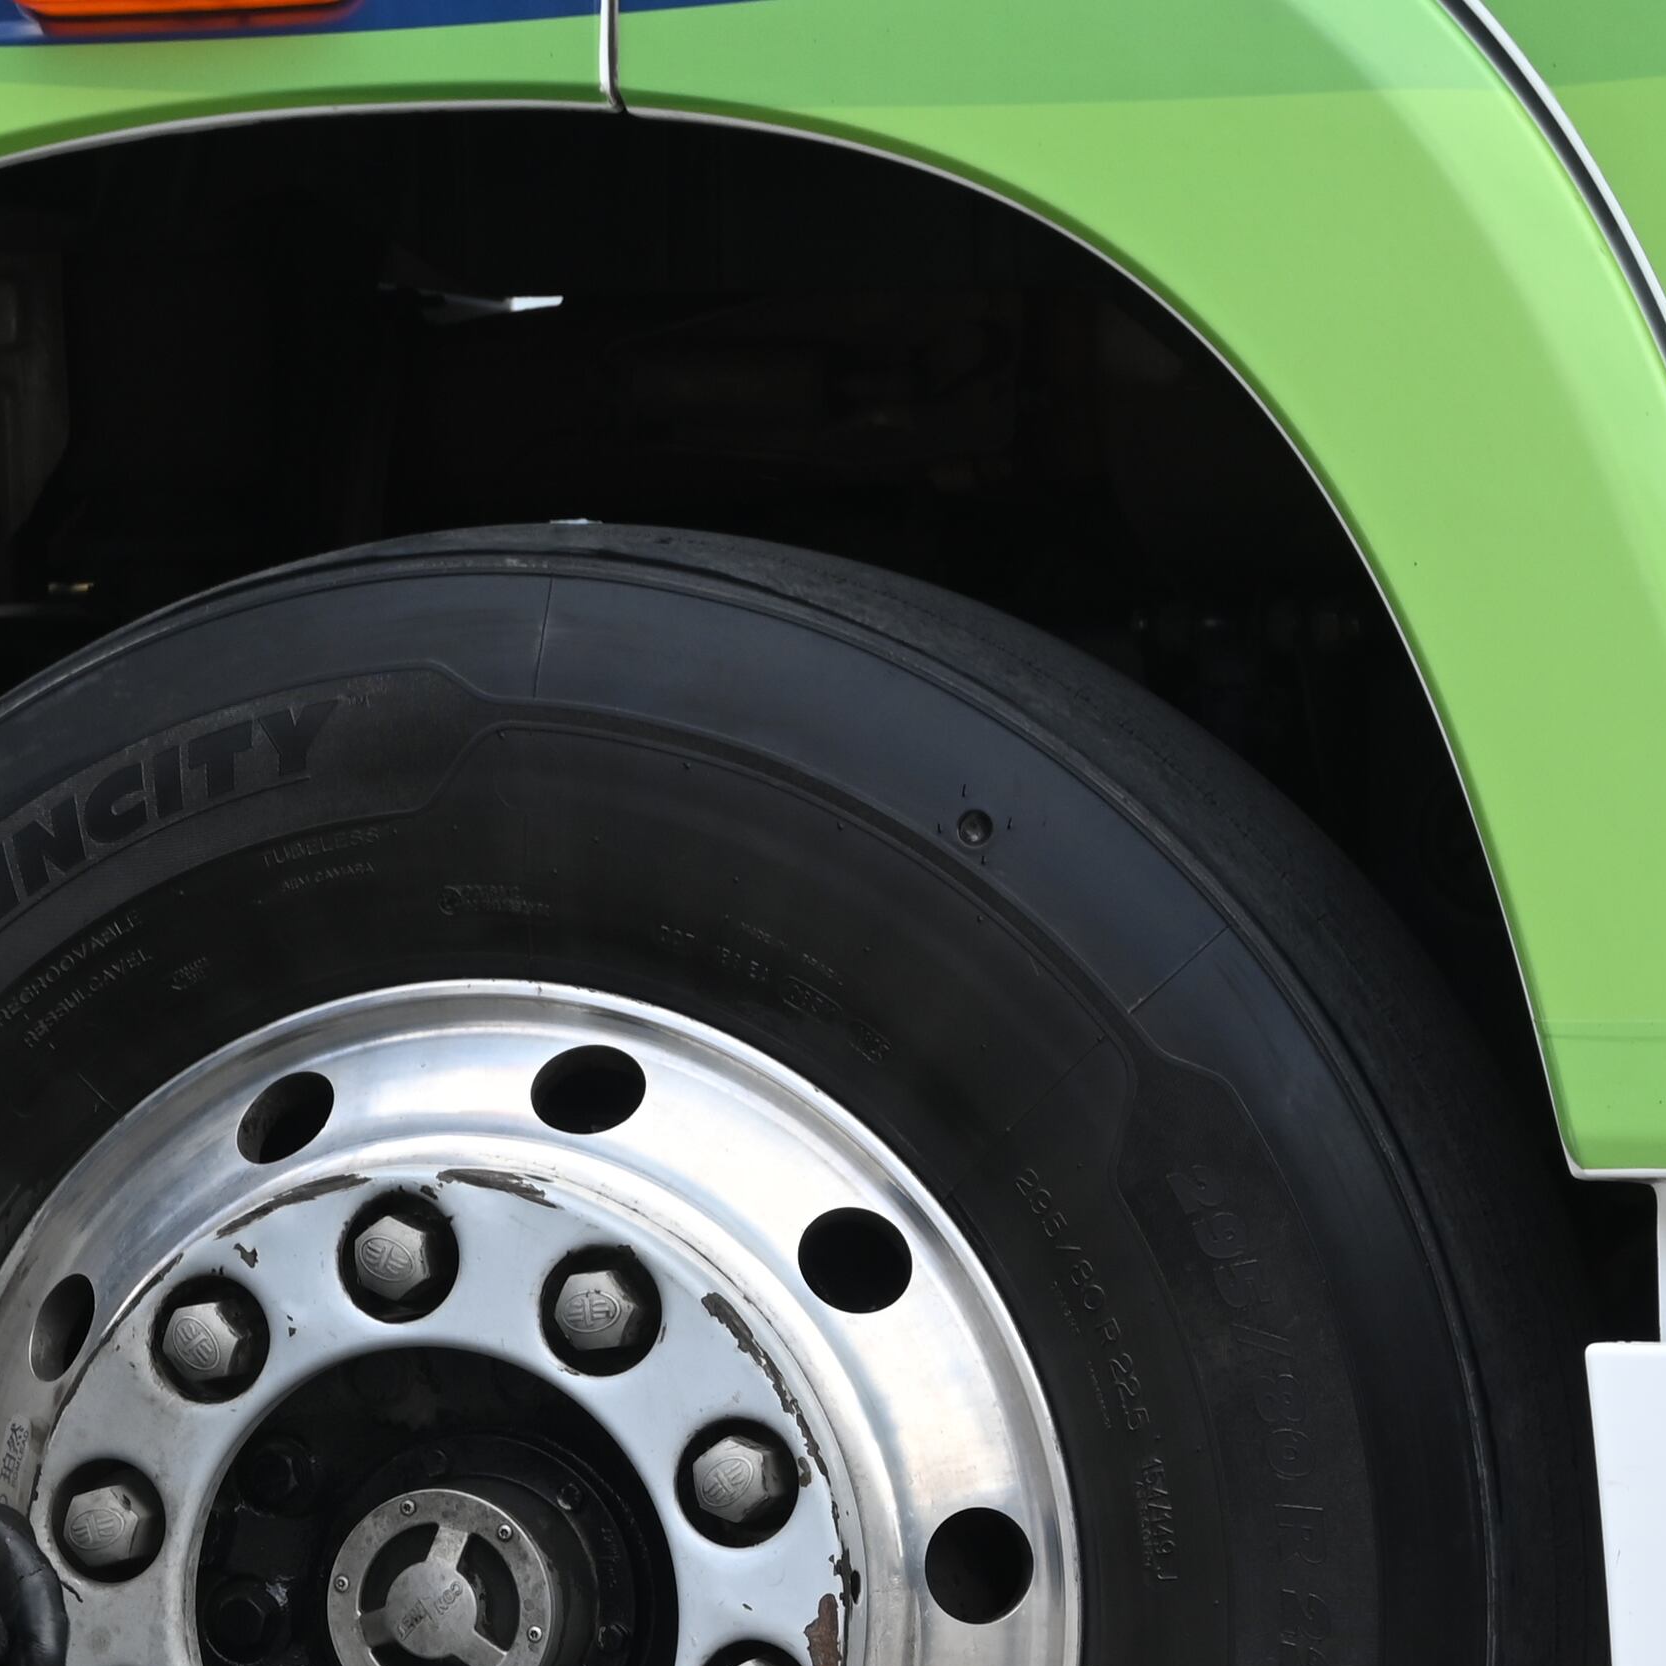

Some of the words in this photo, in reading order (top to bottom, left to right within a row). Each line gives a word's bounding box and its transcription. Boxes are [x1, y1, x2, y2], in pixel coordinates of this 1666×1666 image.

[1094, 1315, 1122, 1346] R
[1109, 1352, 1151, 1432] 22.5
[1273, 1502, 1327, 1567] R
